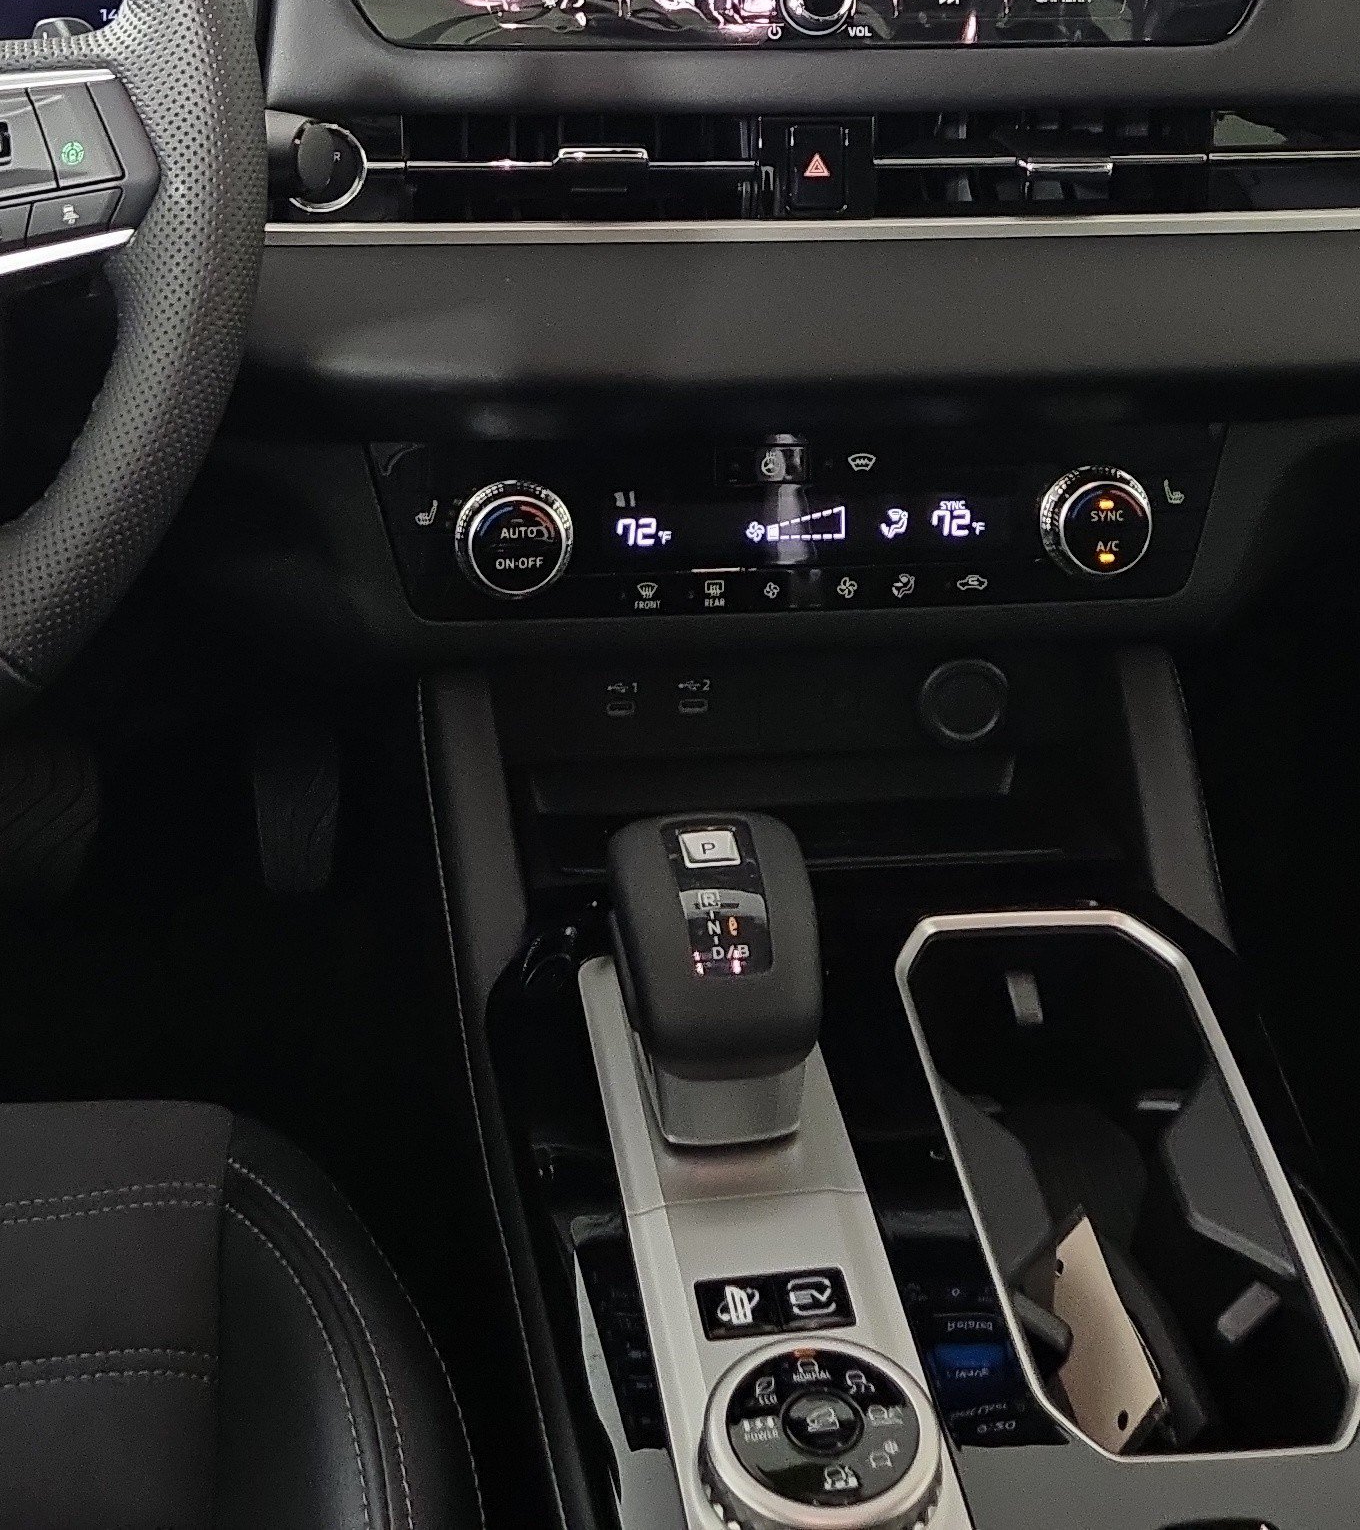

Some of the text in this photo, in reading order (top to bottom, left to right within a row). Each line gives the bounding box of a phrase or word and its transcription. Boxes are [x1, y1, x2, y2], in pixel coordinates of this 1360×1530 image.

[100, 8, 118, 21] 14
[848, 26, 872, 38] VOL
[940, 500, 966, 510] SYNC
[1090, 510, 1124, 522] SYNC
[500, 526, 537, 539] AUTO
[1096, 539, 1119, 552] A/C
[634, 600, 662, 609] FRONT
[704, 598, 725, 608] REAR
[703, 679, 711, 691] 2
[701, 842, 715, 854] P
[704, 892, 715, 904] R
[707, 920, 721, 935] N
[744, 1429, 778, 1442] POWER
